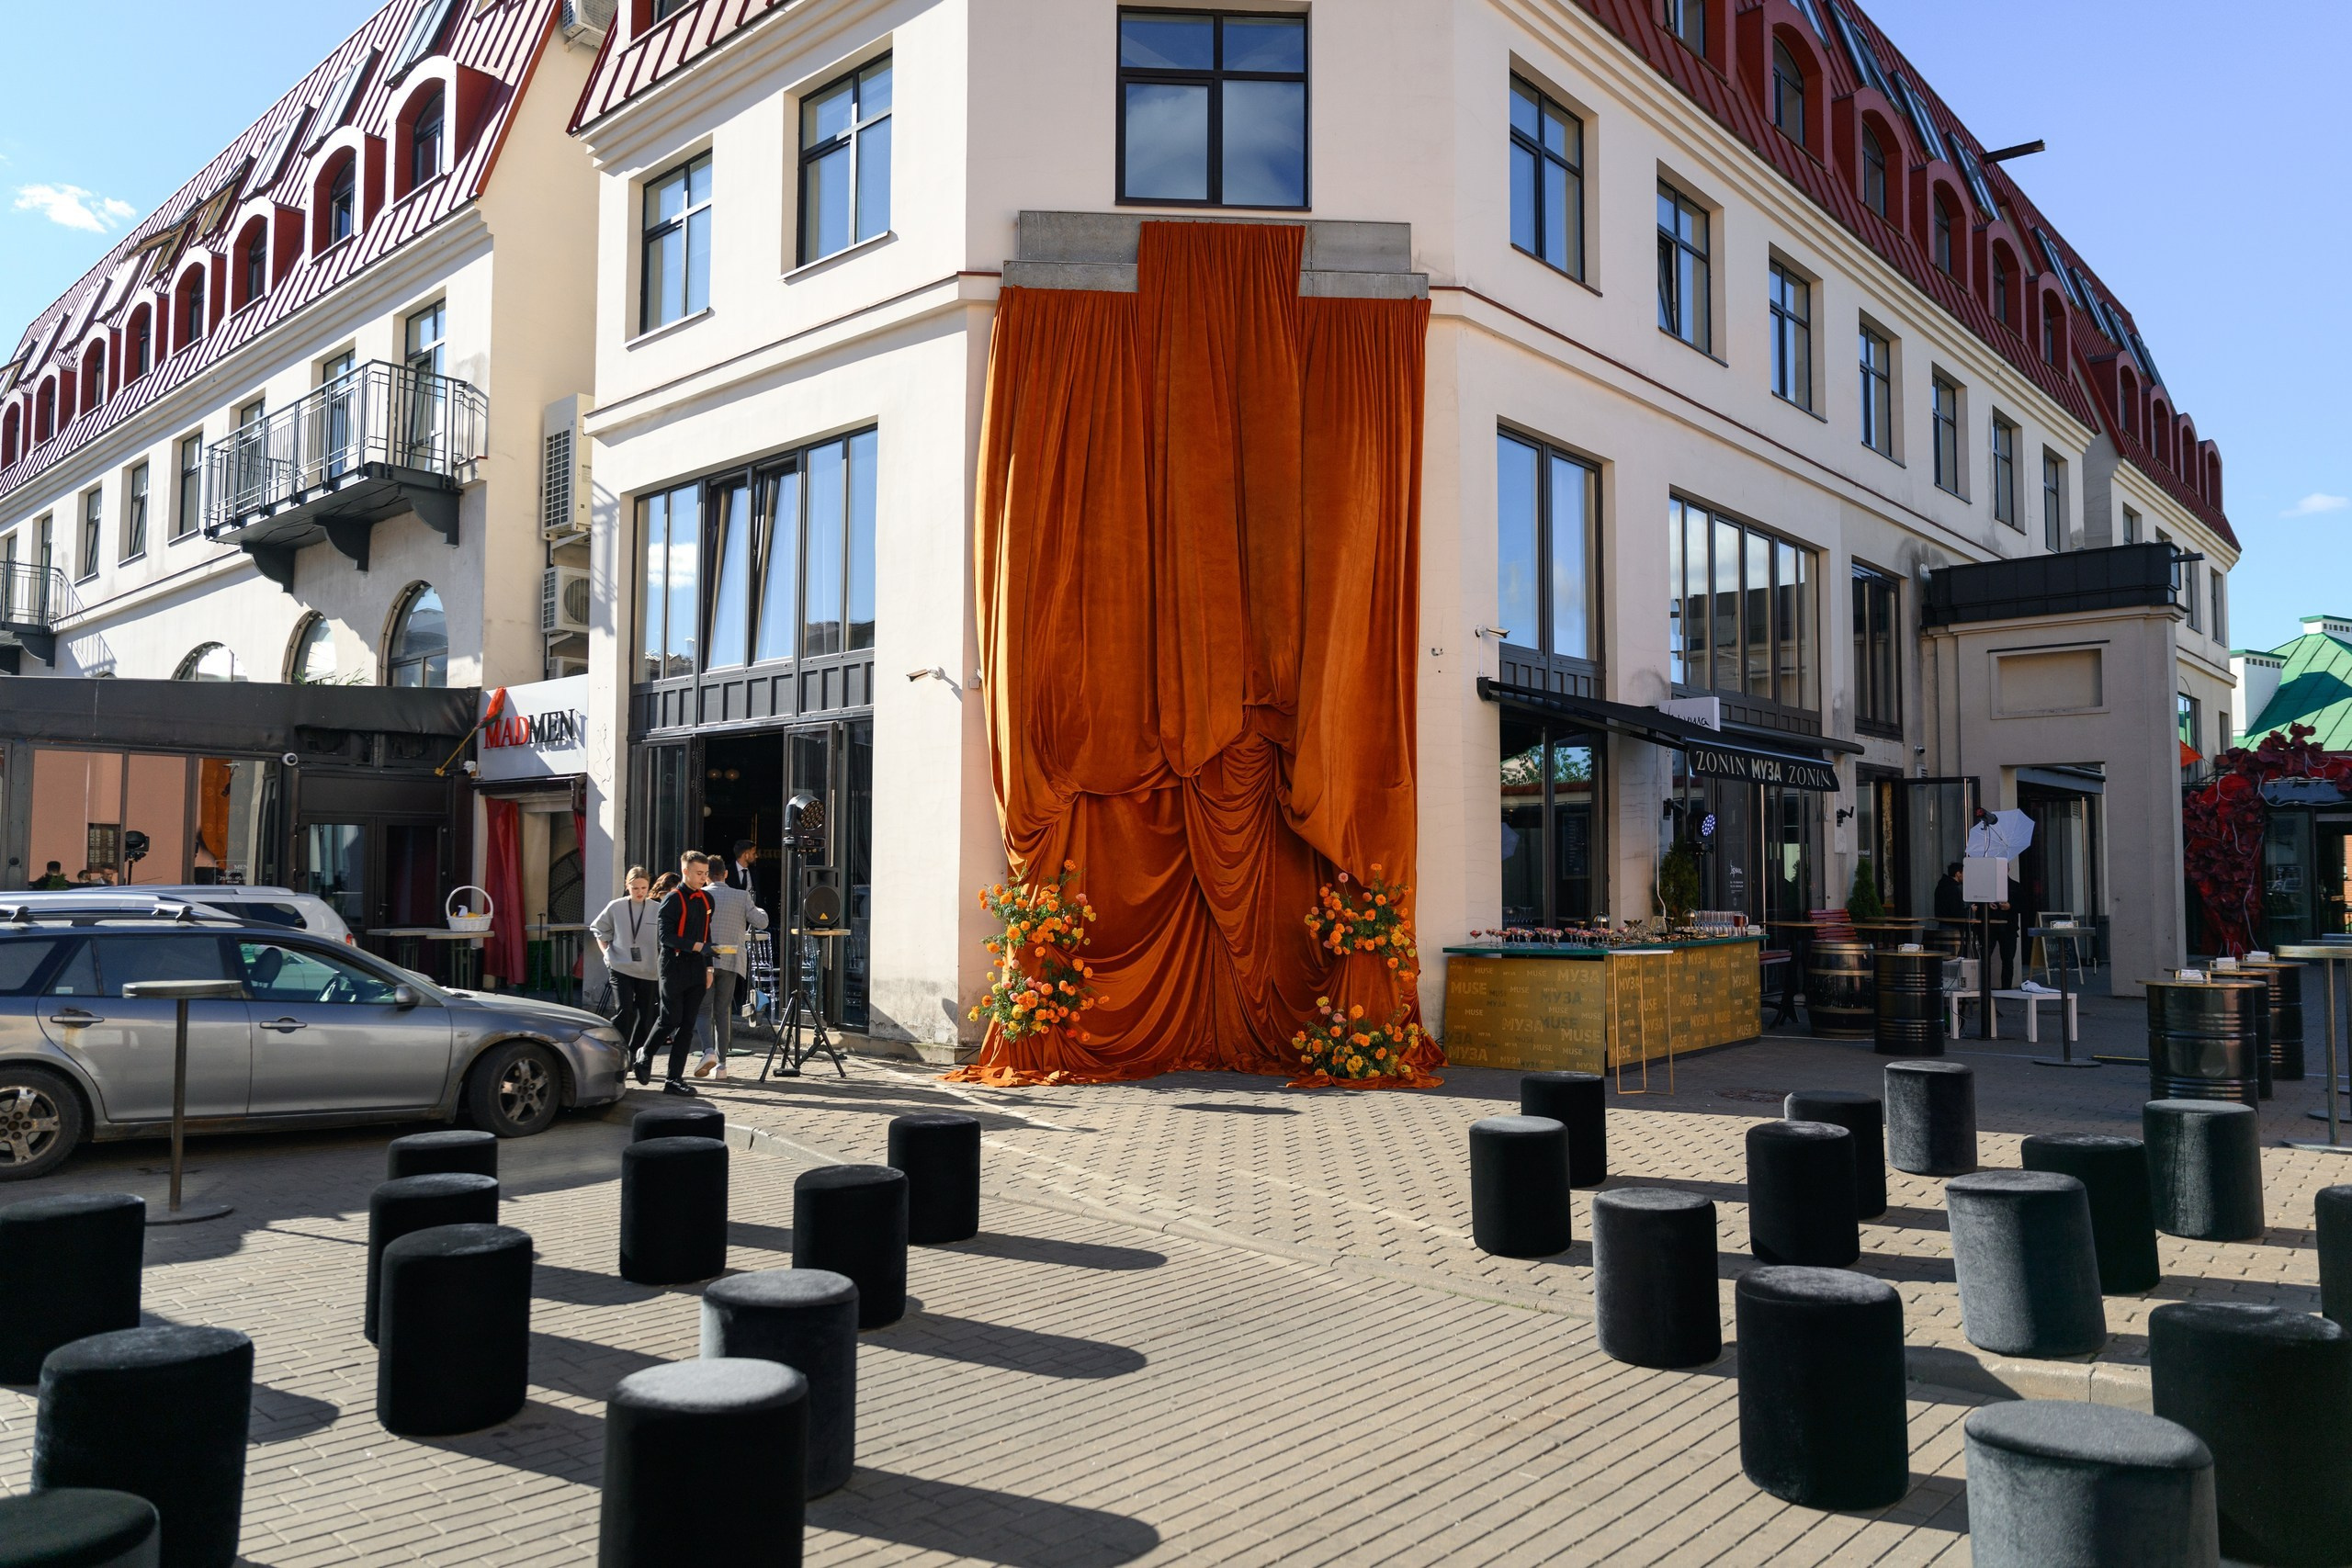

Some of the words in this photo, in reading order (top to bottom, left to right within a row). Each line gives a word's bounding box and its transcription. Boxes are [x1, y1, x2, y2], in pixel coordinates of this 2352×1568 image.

[484, 708, 575, 750] MADMEN
[1695, 750, 1747, 775] ZONIN
[1751, 758, 1781, 783] МУЗА
[1788, 765, 1832, 787] ZONIN
[1616, 956, 1637, 971] MUSE
[1688, 952, 1707, 965] МУЗА
[1710, 956, 1726, 970] MUSE
[1475, 966, 1493, 975] MUSE
[1557, 969, 1600, 984] МУЗА
[1618, 976, 1641, 991] МУЗА
[1733, 974, 1750, 987] МУЗА
[1451, 981, 1487, 996] MUSE
[1510, 986, 1529, 994] MUSE
[1541, 992, 1582, 1005] МУЗА
[1679, 993, 1698, 1007] MUSE
[1540, 1016, 1578, 1029] MUSE
[1581, 1012, 1602, 1021] MUSE
[1690, 1013, 1710, 1027] МУЗА
[1501, 1017, 1544, 1032] МУЗА
[1644, 1018, 1664, 1032] МУЗА
[1736, 1023, 1752, 1037] MUSE
[1561, 1028, 1601, 1043] MUSE
[1448, 1045, 1488, 1062] МУЗА
[1562, 1047, 1583, 1055] MUSE
[1499, 1055, 1521, 1065] МУЗА
[1576, 1062, 1599, 1071] МУЗА
